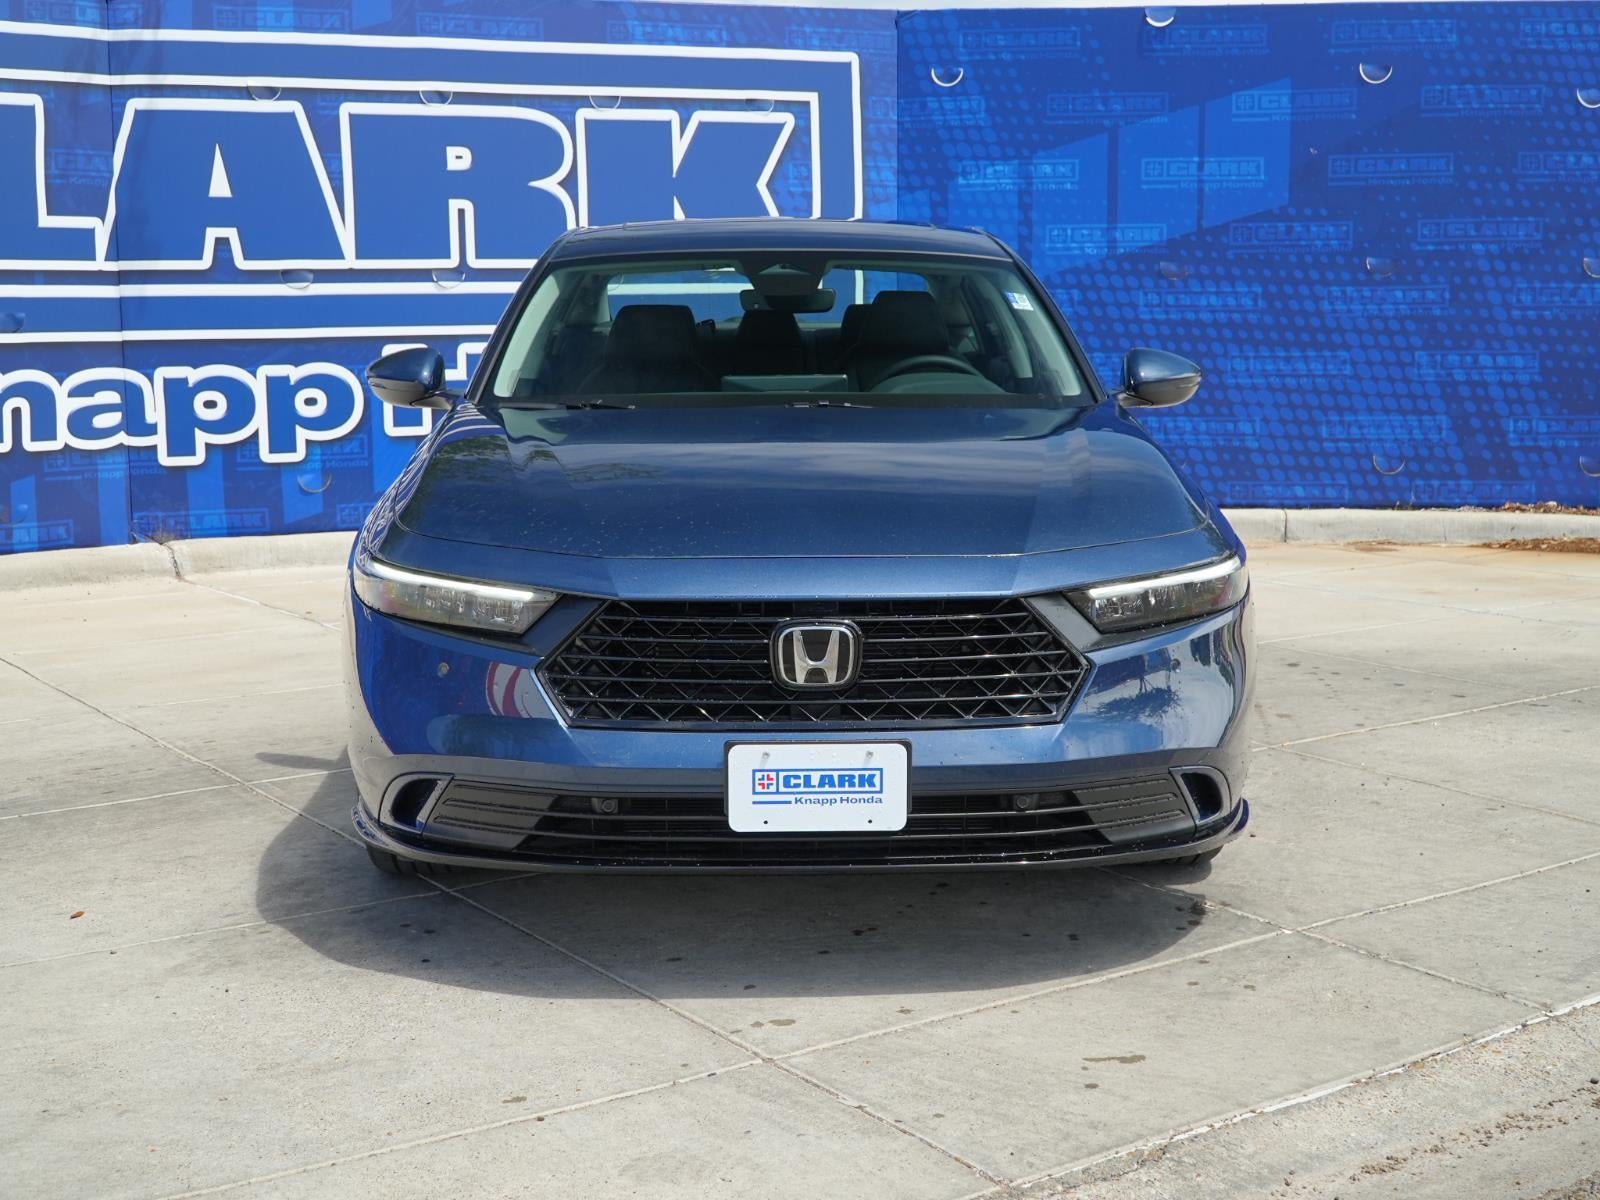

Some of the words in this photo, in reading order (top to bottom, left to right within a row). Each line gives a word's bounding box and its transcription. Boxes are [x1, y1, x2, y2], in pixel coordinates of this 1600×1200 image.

[783, 773, 877, 789] CLARK
[794, 796, 837, 806] Knapp
[840, 795, 883, 805] Honda
